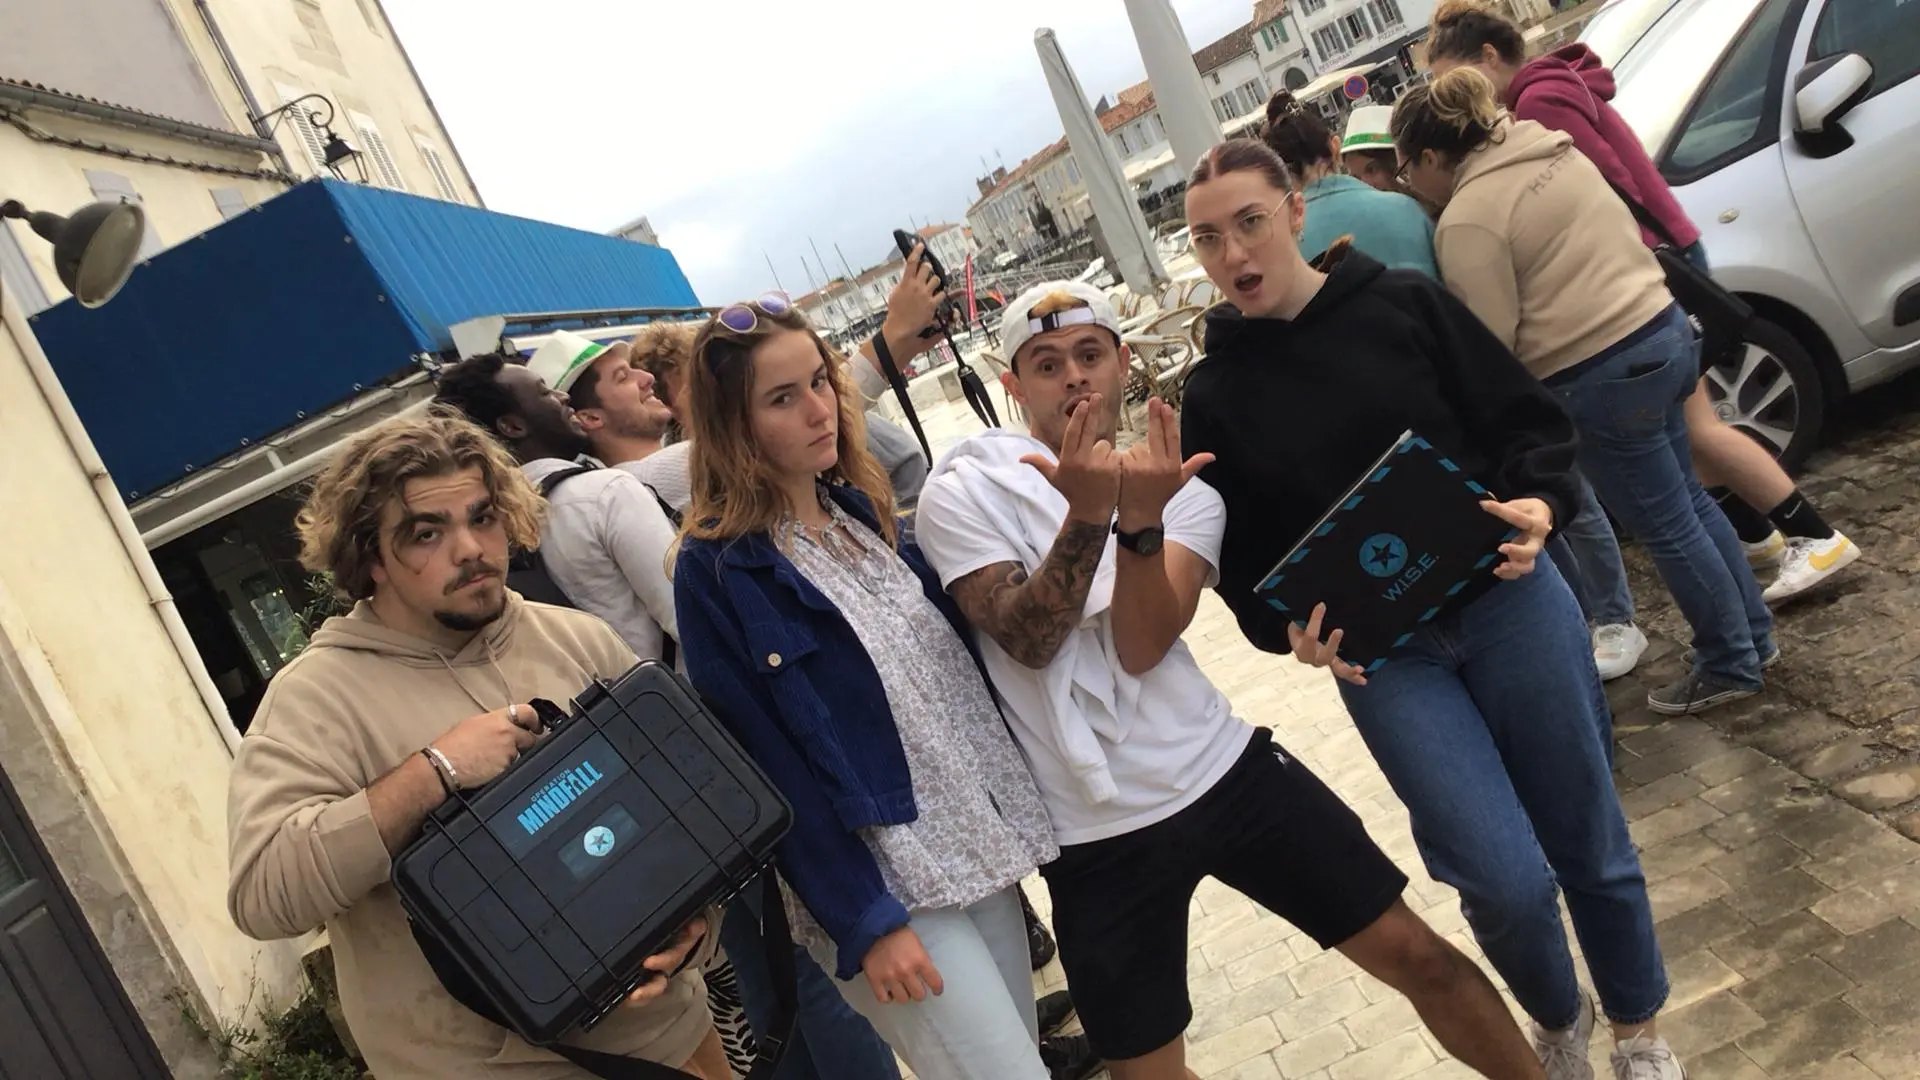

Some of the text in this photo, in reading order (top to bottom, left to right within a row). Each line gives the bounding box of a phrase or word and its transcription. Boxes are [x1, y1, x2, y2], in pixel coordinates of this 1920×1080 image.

[1381, 552, 1440, 601] W.I.S.E.
[517, 760, 604, 836] MINDFALL
[530, 768, 571, 802] OPERATION
